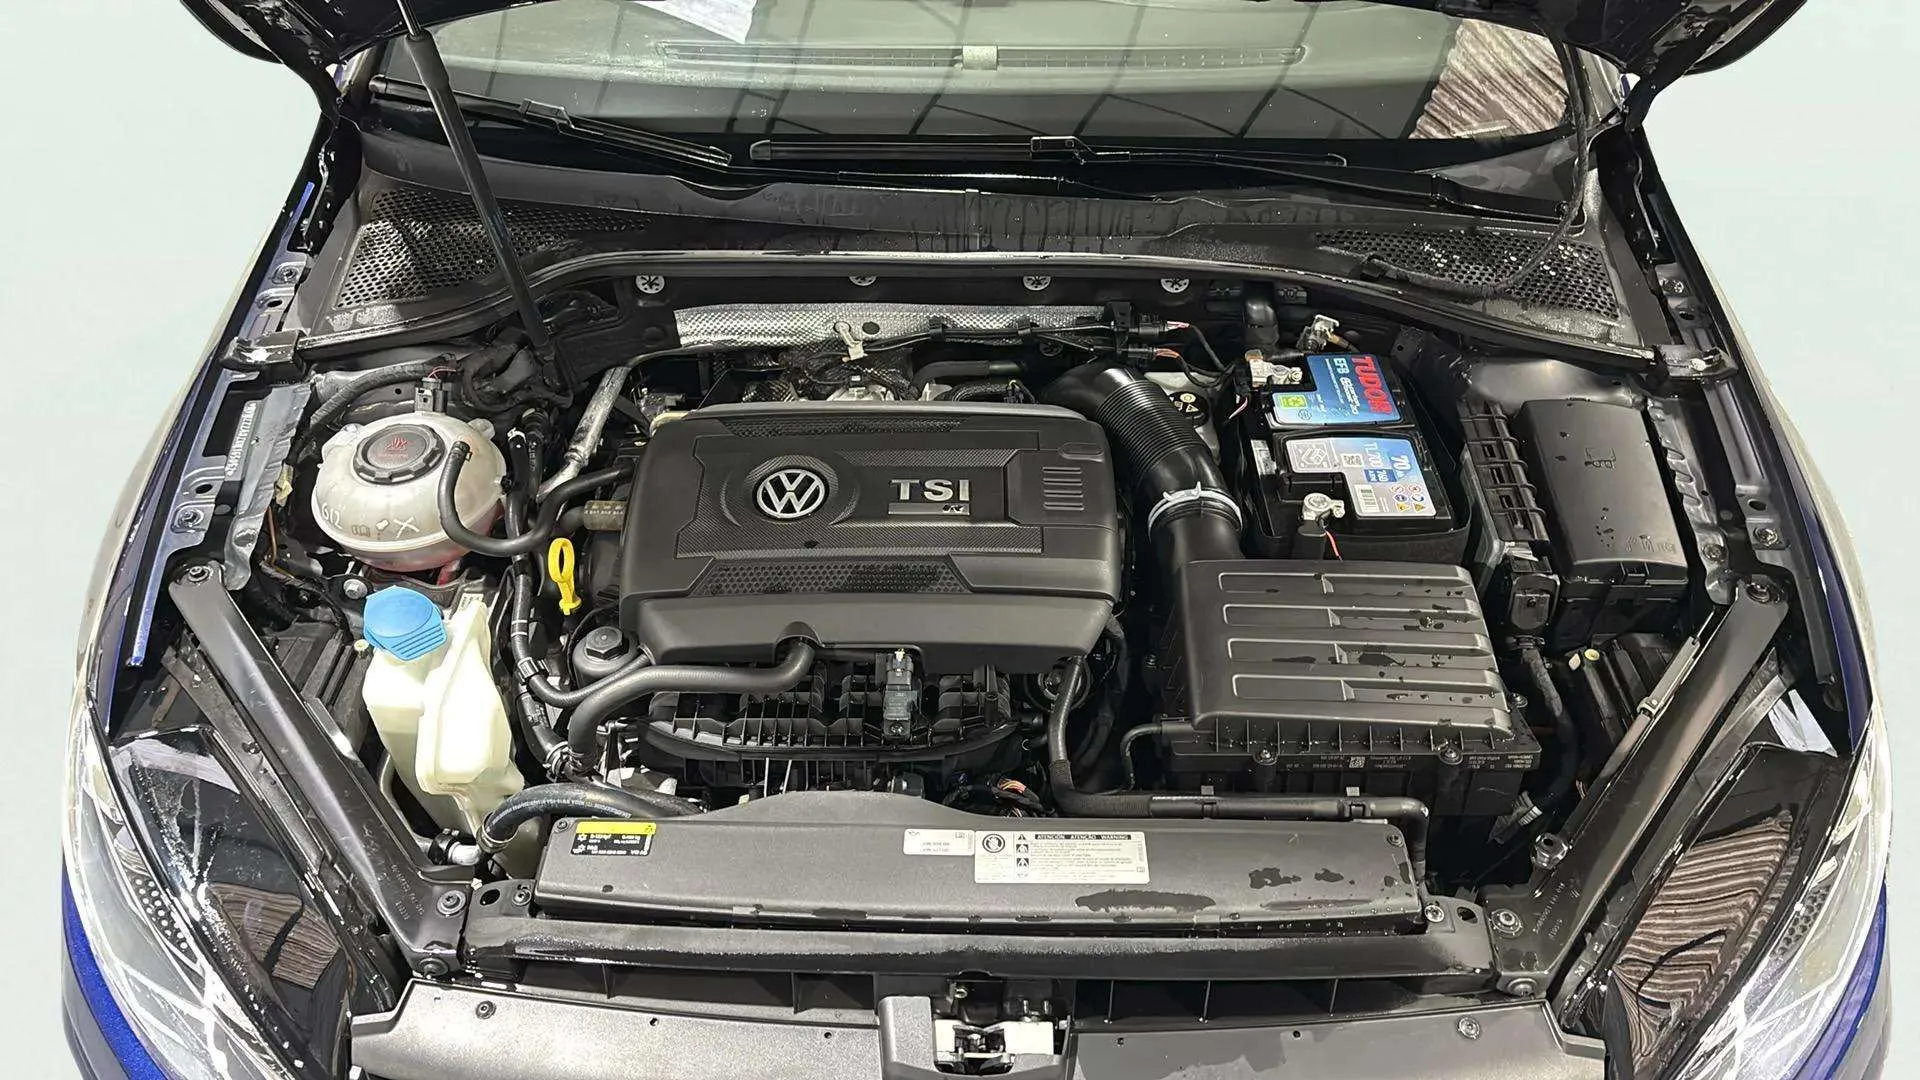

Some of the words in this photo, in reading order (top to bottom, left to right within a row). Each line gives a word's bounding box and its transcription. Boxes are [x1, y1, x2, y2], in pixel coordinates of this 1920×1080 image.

[1333, 357, 1350, 374] EFB
[1350, 355, 1393, 414] TUDOR
[1390, 454, 1412, 471] 70
[757, 468, 826, 519] VW
[891, 479, 970, 502] TSI
